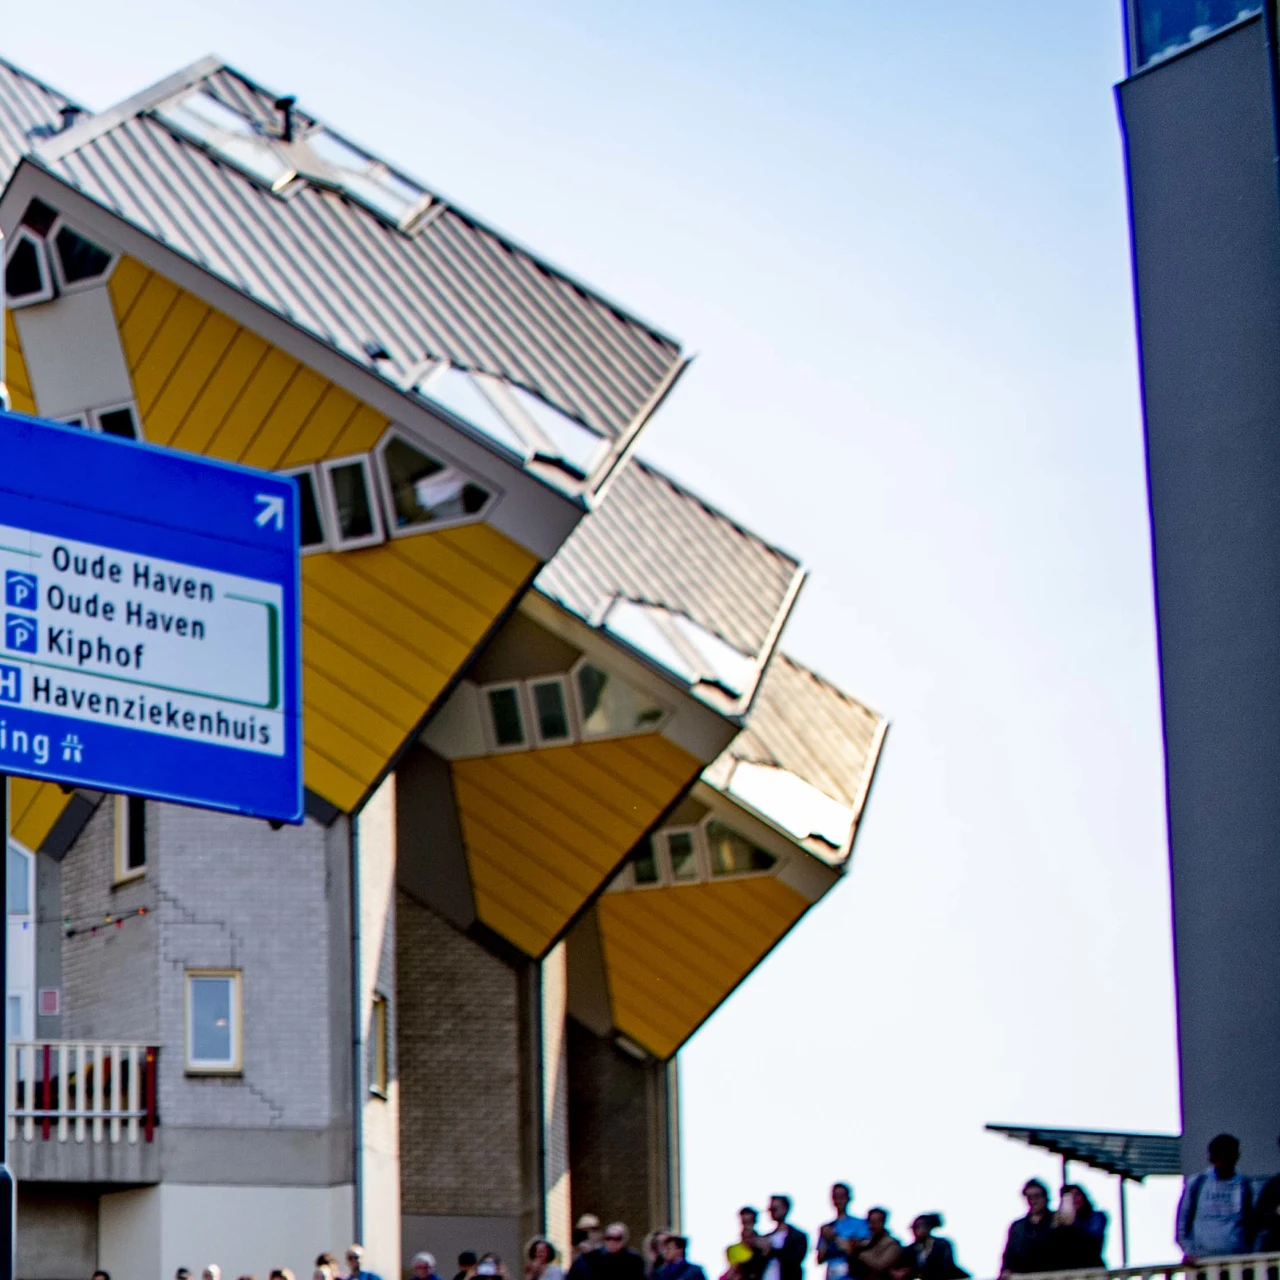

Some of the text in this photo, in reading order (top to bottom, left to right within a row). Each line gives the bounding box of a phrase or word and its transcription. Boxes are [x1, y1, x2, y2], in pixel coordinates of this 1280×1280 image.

[52, 545, 214, 603] Oude Haven
[47, 584, 115, 621] Oude
[126, 600, 205, 640] Haven
[48, 626, 144, 670] Kiphof
[33, 675, 270, 745] Havenziekenhuis
